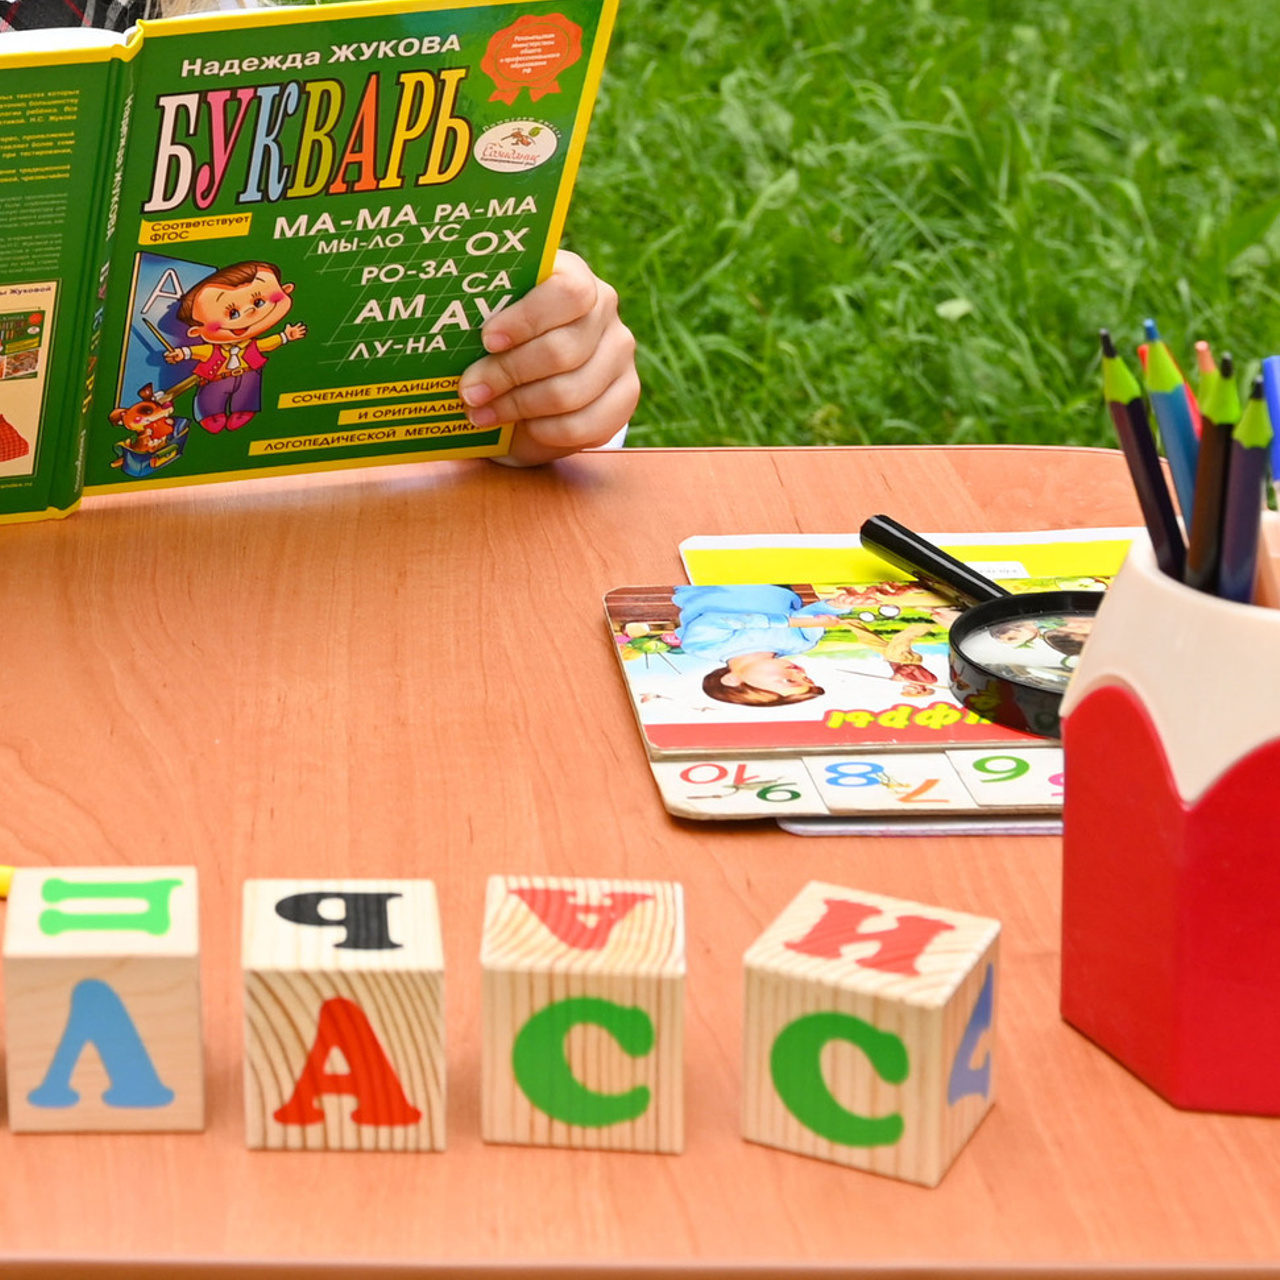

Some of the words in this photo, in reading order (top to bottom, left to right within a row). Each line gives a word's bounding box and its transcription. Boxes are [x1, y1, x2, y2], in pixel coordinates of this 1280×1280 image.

[180, 50, 321, 78] Надежда
[327, 34, 461, 64] ЖУКОВА
[140, 65, 472, 214] БУКВАРЬ
[106, 170, 122, 241] ЖУКОВА
[273, 204, 418, 239] МА-МА
[434, 195, 538, 222] РА-МА
[150, 230, 190, 242] ФГОС
[151, 216, 250, 232] Соответствует
[317, 233, 404, 254] МЫ-ЛО
[420, 223, 462, 244] УС
[465, 227, 531, 256] ОХ
[9, 285, 52, 295] Жуковой
[360, 258, 459, 285] РО-ЗА
[461, 270, 513, 293] СА
[353, 294, 426, 324] АМ
[429, 294, 513, 334] АУ
[348, 334, 448, 361] ЛУ-НА
[291, 387, 371, 404] СОЧЕТАНИЕ
[357, 411, 368, 420] И
[264, 429, 397, 451] ЛОГОПЕДИЧЕСКОЙ
[680, 763, 759, 785] 10
[825, 762, 884, 787] 8
[973, 755, 1031, 783] 6
[897, 778, 951, 803] 7
[27, 978, 175, 1108] Л
[273, 997, 422, 1126] А
[511, 995, 655, 1129] С
[770, 1011, 910, 1148] С
